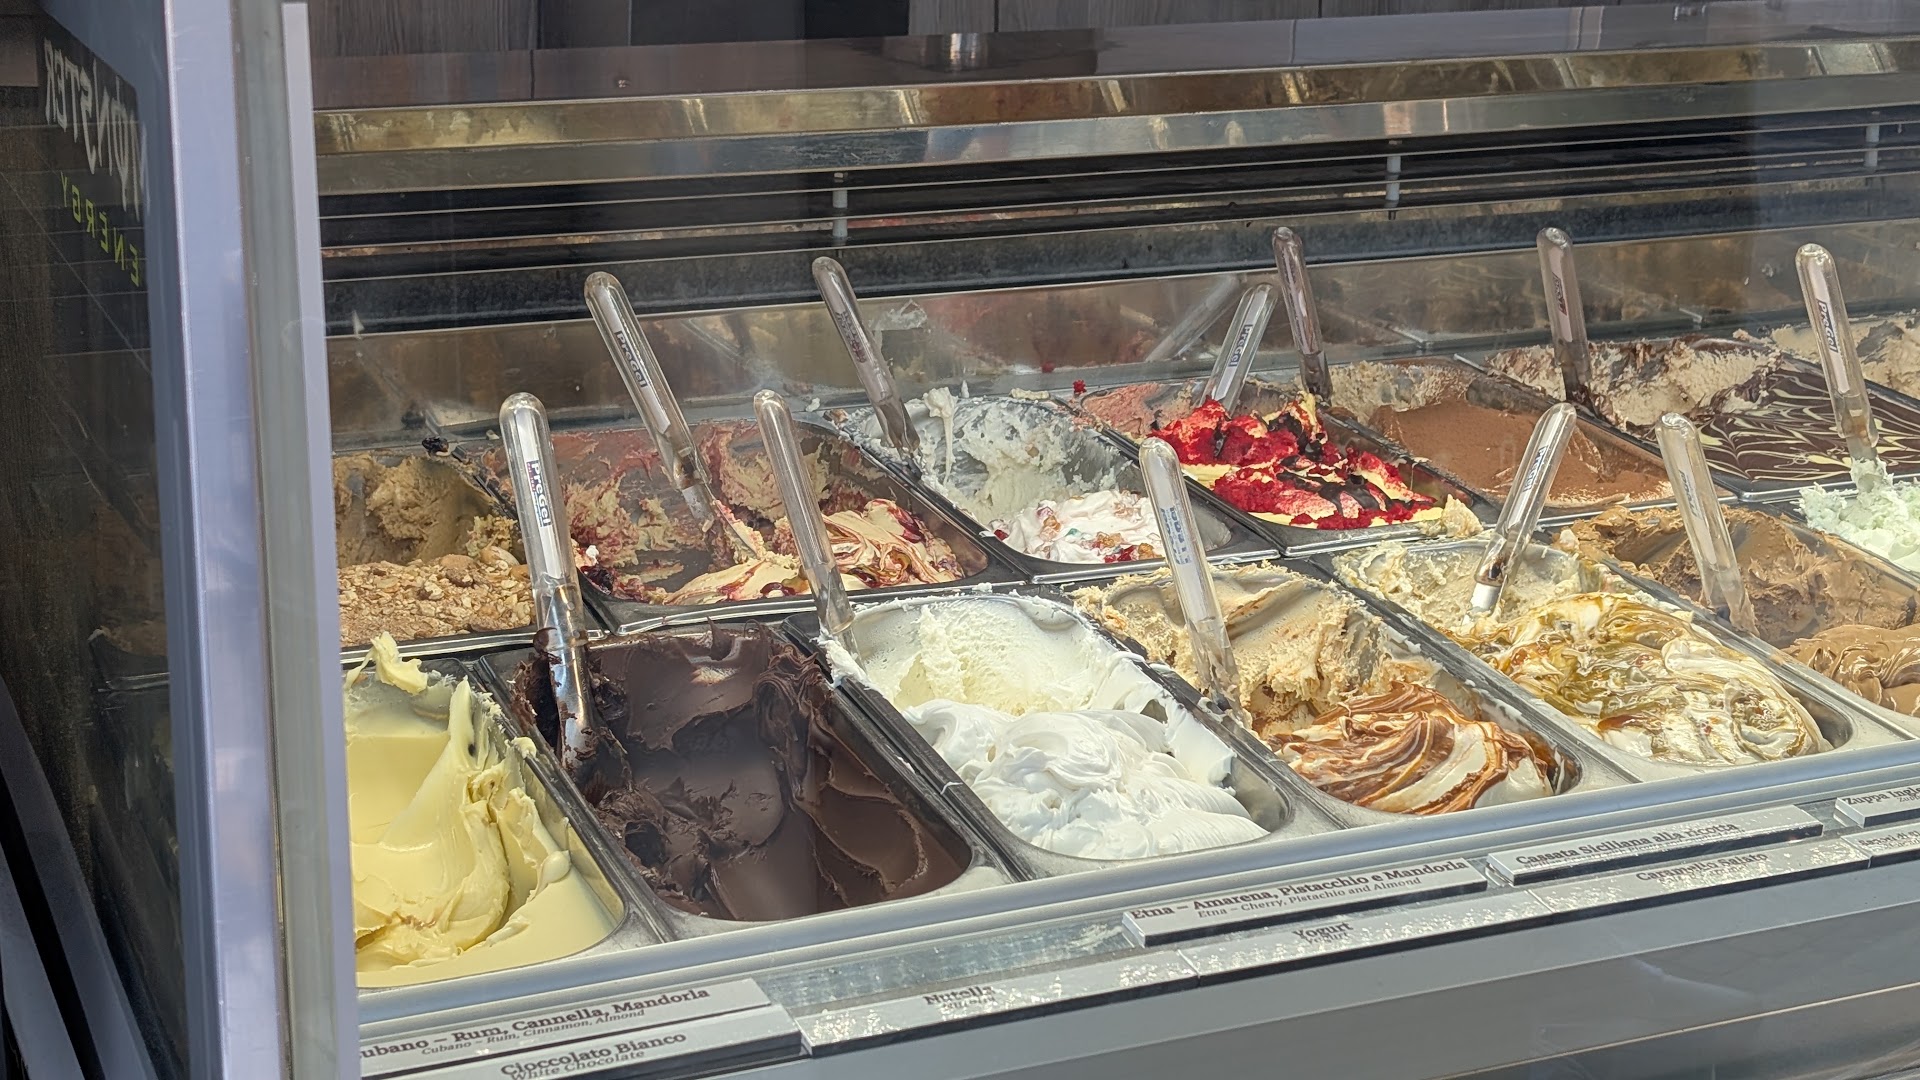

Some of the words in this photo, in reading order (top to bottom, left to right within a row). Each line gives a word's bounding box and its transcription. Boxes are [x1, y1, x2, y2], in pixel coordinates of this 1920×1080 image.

[1229, 326, 1253, 365] PreGel
[1818, 302, 1837, 351] PreGel
[616, 332, 647, 385] PreGel
[531, 463, 552, 524] PreGel
[1840, 793, 1890, 805] Zuppa
[1516, 849, 1580, 864] Cassata
[1578, 836, 1649, 854] Siciliana
[1653, 831, 1683, 843] alla
[1684, 823, 1739, 837] ricotta
[1717, 853, 1768, 867] Salato
[1131, 906, 1175, 920] Etna
[1193, 891, 1279, 910] Amarena,
[1279, 875, 1369, 896] Pistacchio
[1371, 873, 1384, 882] e
[1384, 861, 1469, 881] Mandorla
[1198, 908, 1228, 919] Etna
[1241, 898, 1288, 912] Cherry,
[1289, 889, 1346, 904] Pistachio
[1348, 885, 1371, 895] and
[1374, 877, 1422, 891] Almond
[1292, 922, 1353, 939] Yogurt
[923, 986, 995, 1005] Nutella
[360, 1040, 429, 1060] ubano
[451, 1026, 508, 1043] Rum,
[511, 1007, 610, 1031] Cannella,
[612, 988, 710, 1014] Mandorla
[421, 1040, 472, 1055] Cubano
[486, 1032, 520, 1044] Rum,
[523, 1020, 593, 1037] Cinnamon,
[595, 1009, 646, 1025] Almond
[501, 1046, 612, 1076] Cioccolato
[614, 1032, 687, 1055] Bianco
[510, 1066, 560, 1080] White
[564, 1050, 646, 1072] Chocolate
